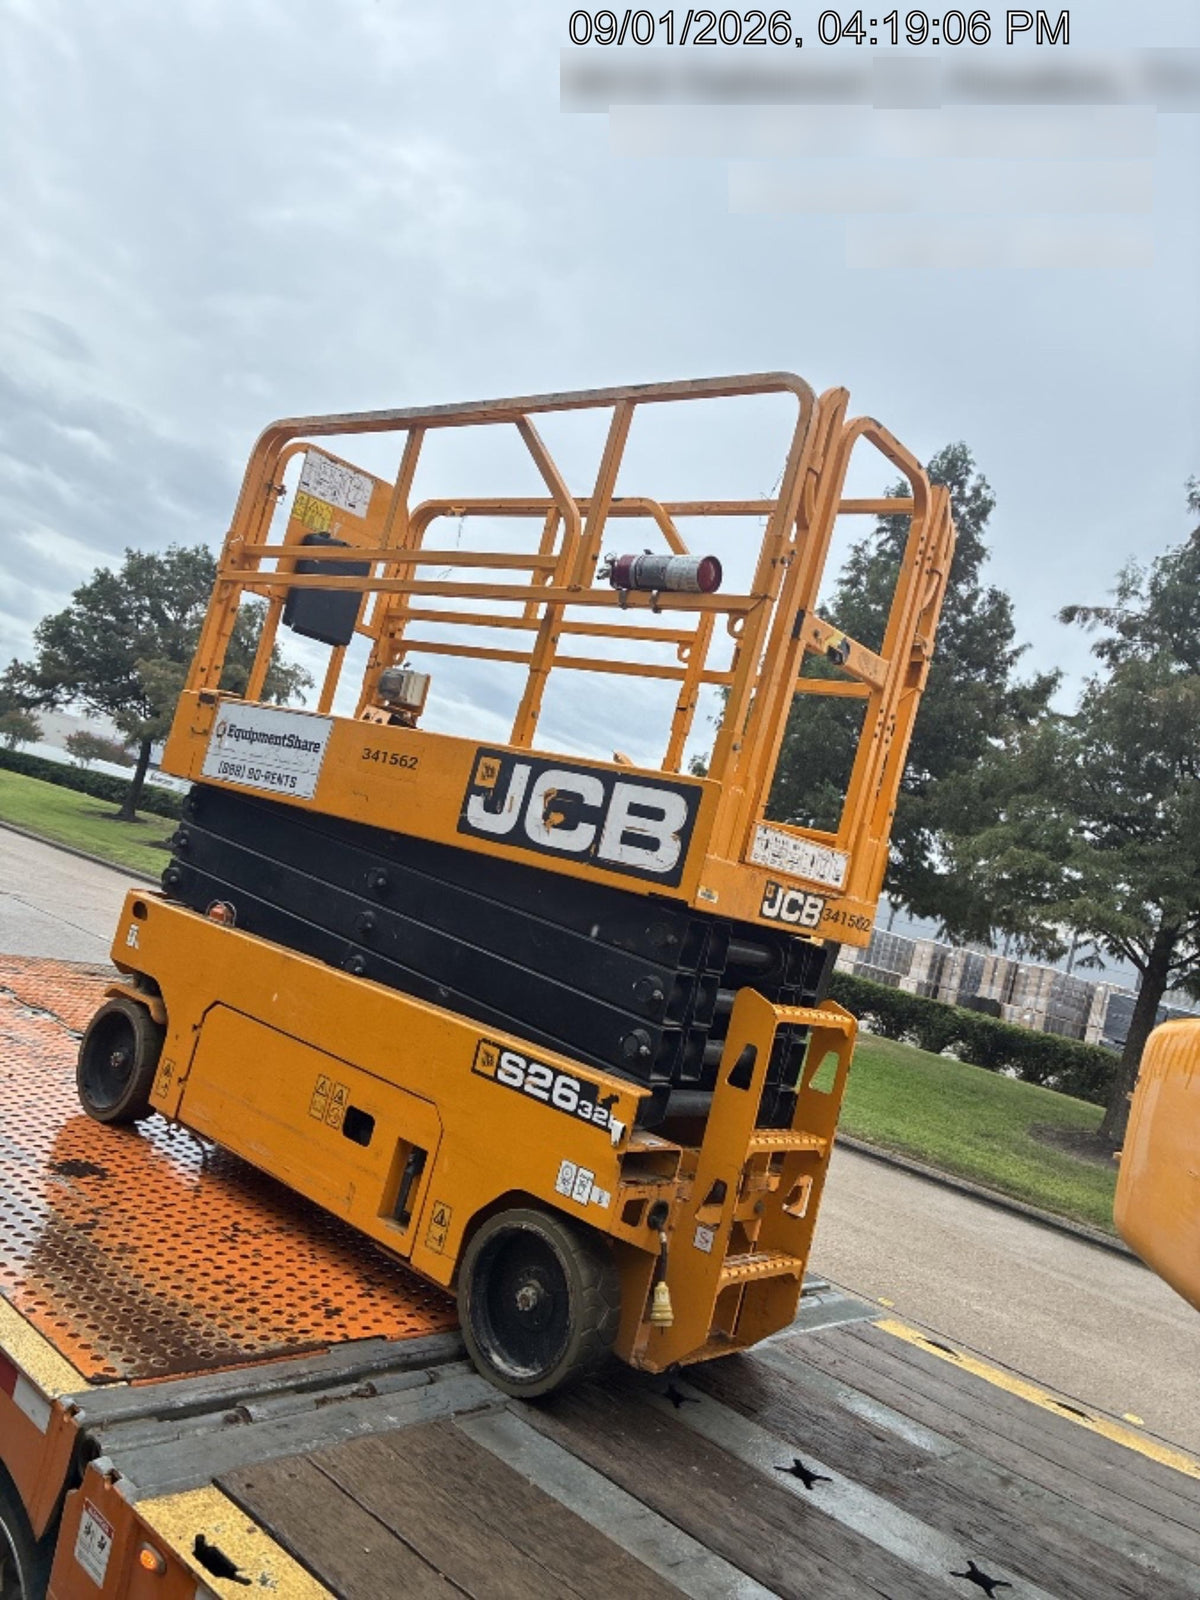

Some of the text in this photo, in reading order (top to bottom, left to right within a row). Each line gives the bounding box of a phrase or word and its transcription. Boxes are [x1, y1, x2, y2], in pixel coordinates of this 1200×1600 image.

[226, 724, 321, 753] EquipmentShare
[361, 748, 418, 771] 341562
[467, 763, 688, 873] JCB
[761, 885, 825, 928] JCB
